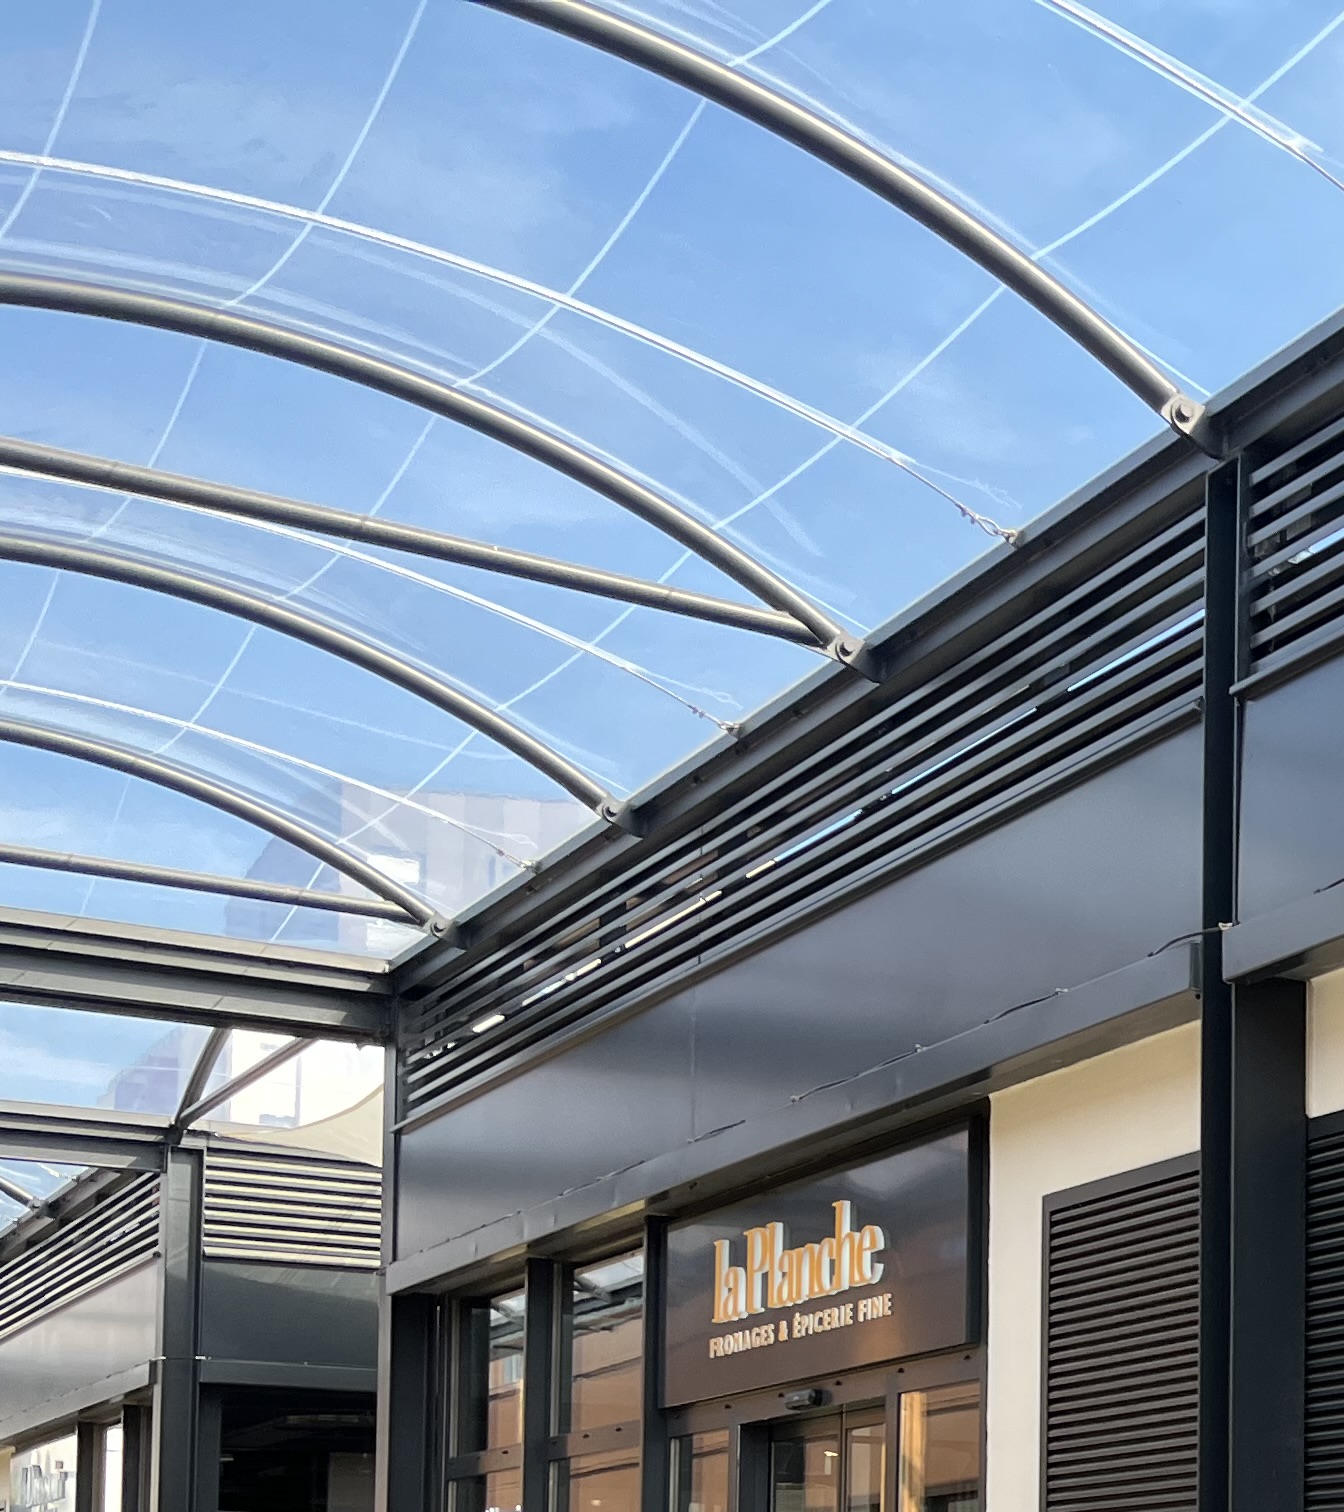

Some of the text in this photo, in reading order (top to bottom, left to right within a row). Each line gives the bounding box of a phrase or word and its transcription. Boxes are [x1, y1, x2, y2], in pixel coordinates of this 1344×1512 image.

[709, 1293, 892, 1358] FROMAGES & ÉPICERIE FINE
